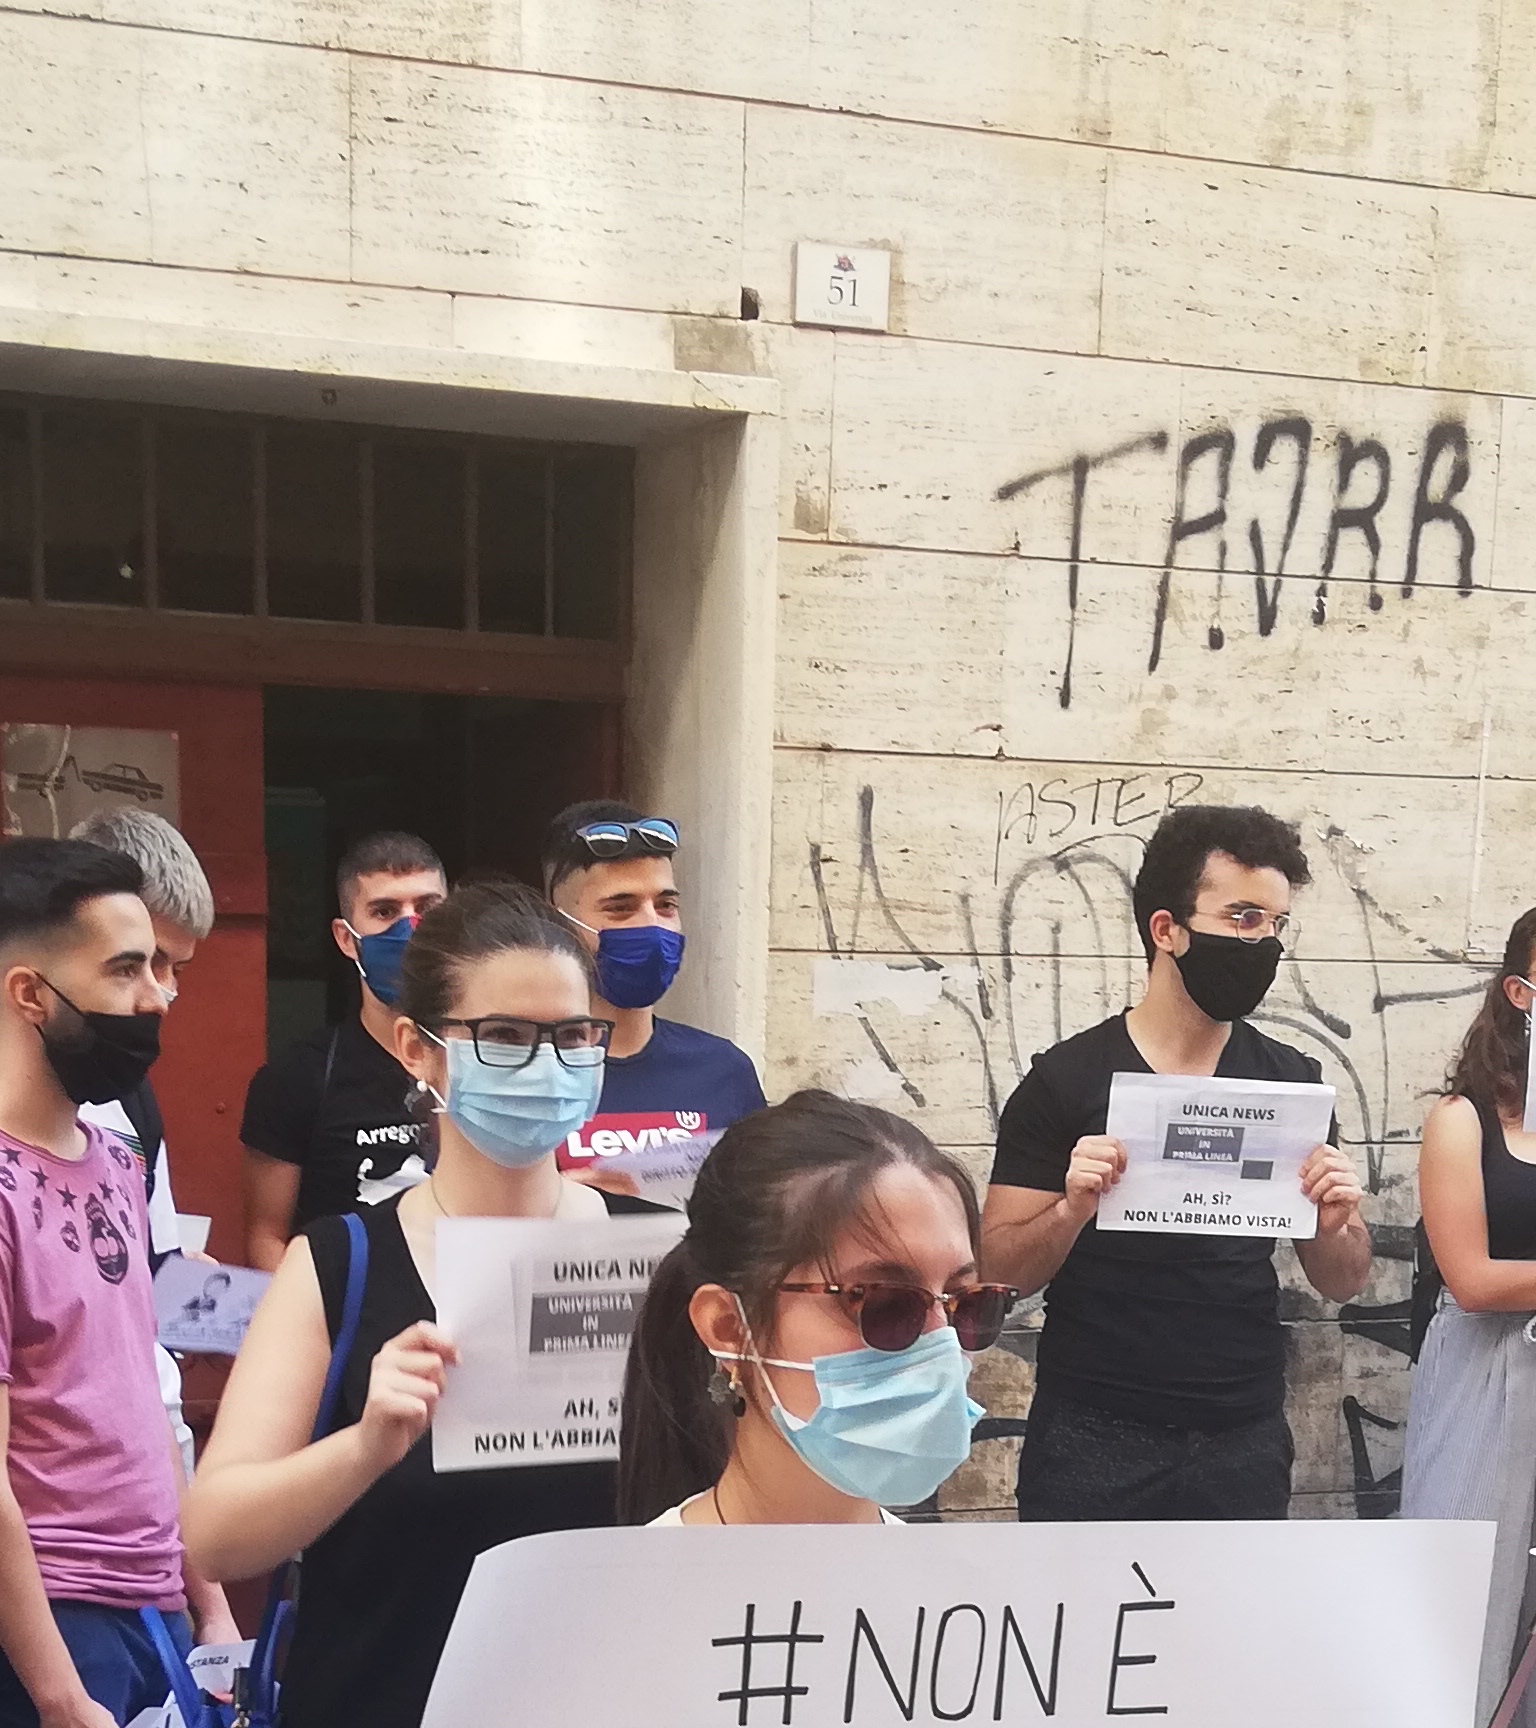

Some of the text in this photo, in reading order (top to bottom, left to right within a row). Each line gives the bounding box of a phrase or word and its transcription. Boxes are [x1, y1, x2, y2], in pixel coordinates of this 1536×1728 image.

[827, 275, 859, 307] 51
[1182, 1104, 1276, 1121] UNICA NEWS
[1177, 1125, 1235, 1139] UNIVERSITÀ
[1198, 1139, 1212, 1150] IN
[1205, 1151, 1234, 1163] LINEA
[1182, 1190, 1232, 1207] AH, SÌ?
[1123, 1209, 1292, 1229] NON L'ABBIAMO VISTA!
[553, 1259, 623, 1283] UNICA
[582, 1314, 600, 1332] IN
[592, 1332, 633, 1350] LINE
[563, 1397, 600, 1421] AH,
[474, 1427, 618, 1455] NON L'ABBIA
[1105, 1561, 1177, 1717] È
[190, 1655, 230, 1669] STANZA
